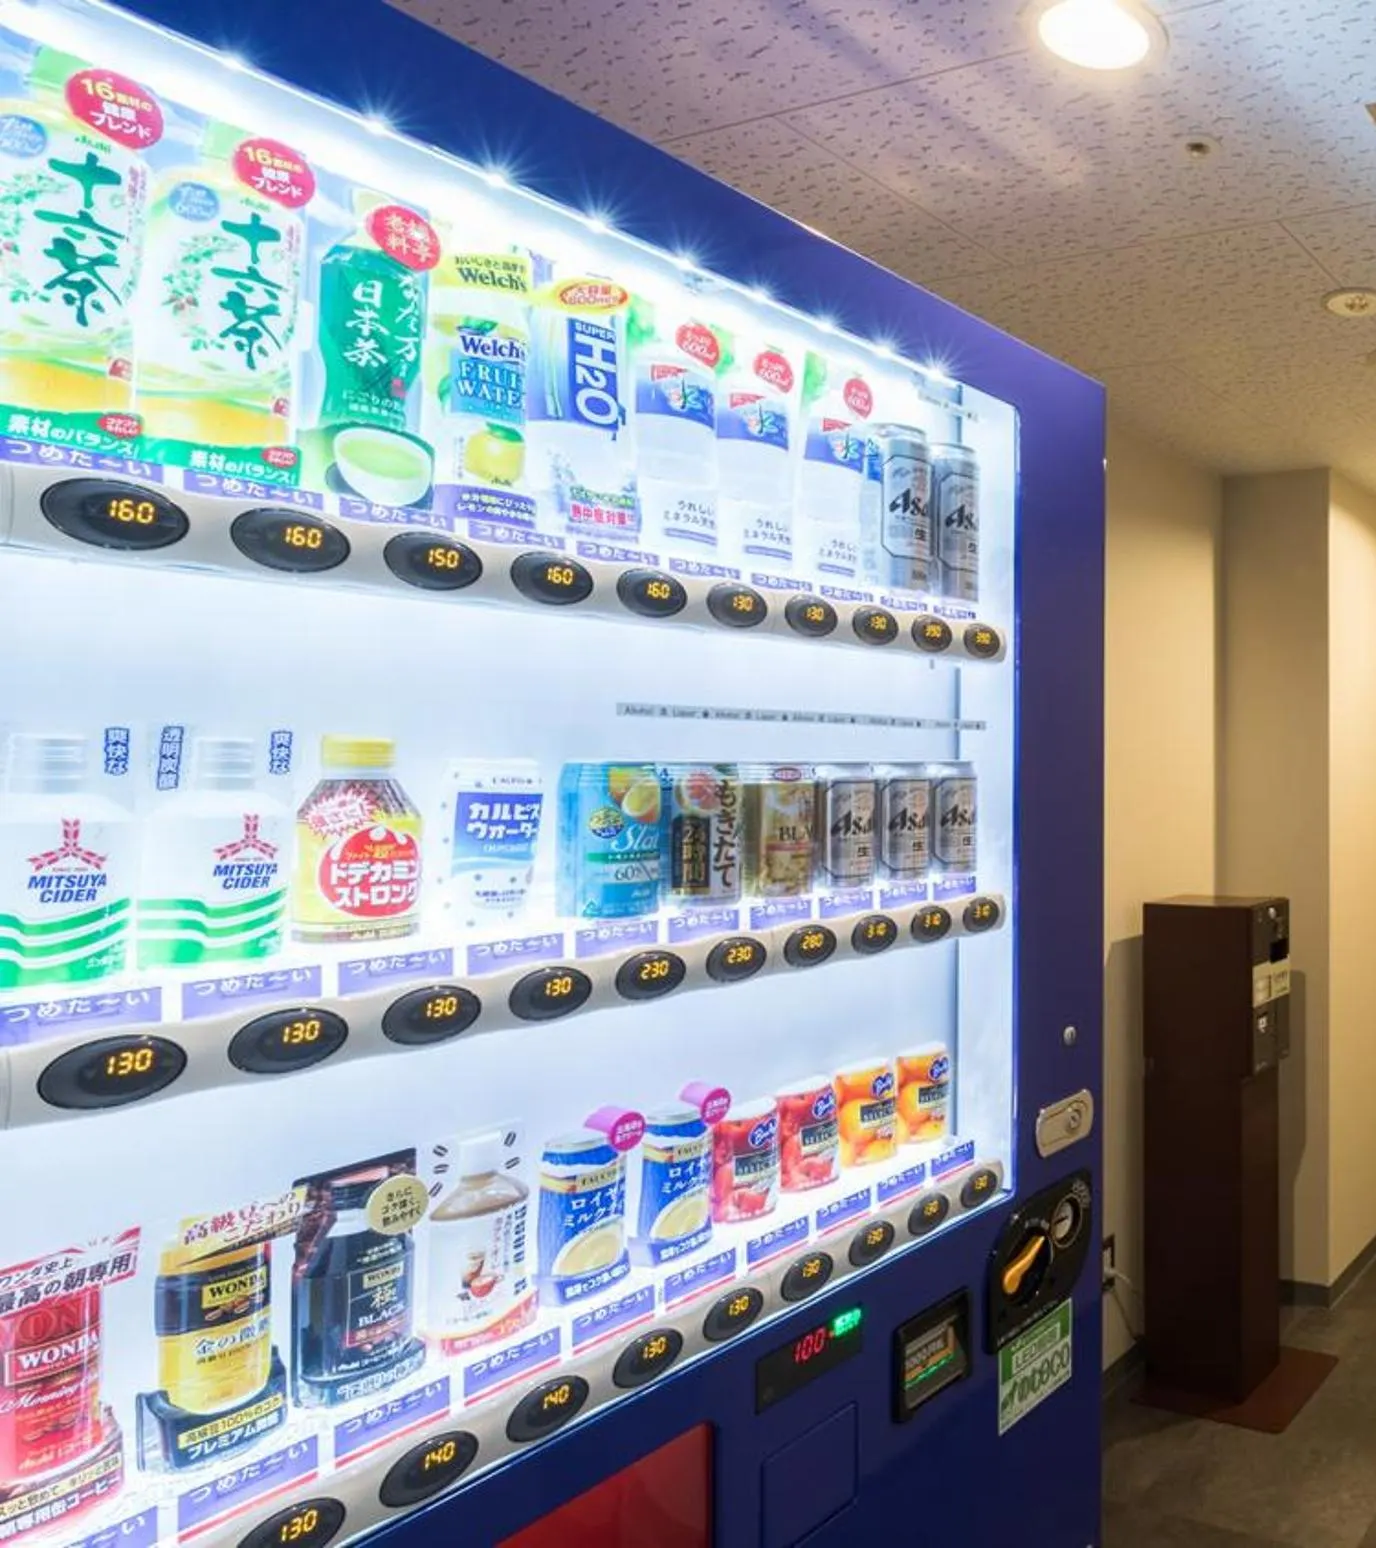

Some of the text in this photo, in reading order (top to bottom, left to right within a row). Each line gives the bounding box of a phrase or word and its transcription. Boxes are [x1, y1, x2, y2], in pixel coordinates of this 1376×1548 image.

[343, 279, 390, 368] 日本茶
[459, 359, 520, 390] FRUI
[456, 379, 522, 409] WATE
[109, 499, 155, 524] 160
[285, 526, 323, 549] 160
[428, 547, 460, 569] 150
[547, 567, 574, 586] 160
[213, 862, 278, 878] MITSUYA
[27, 873, 108, 890] MITSUYA
[222, 875, 271, 891] CIDER
[39, 888, 98, 904] CIDER
[727, 945, 753, 964] 230
[640, 959, 669, 978] 230
[546, 977, 573, 996] 130
[426, 996, 458, 1018] 130
[283, 1019, 321, 1044] 130
[107, 1047, 154, 1076] 130
[643, 1336, 666, 1358] 130
[792, 1328, 829, 1365] 100
[424, 1441, 456, 1467] 140
[281, 1509, 318, 1540] 130
